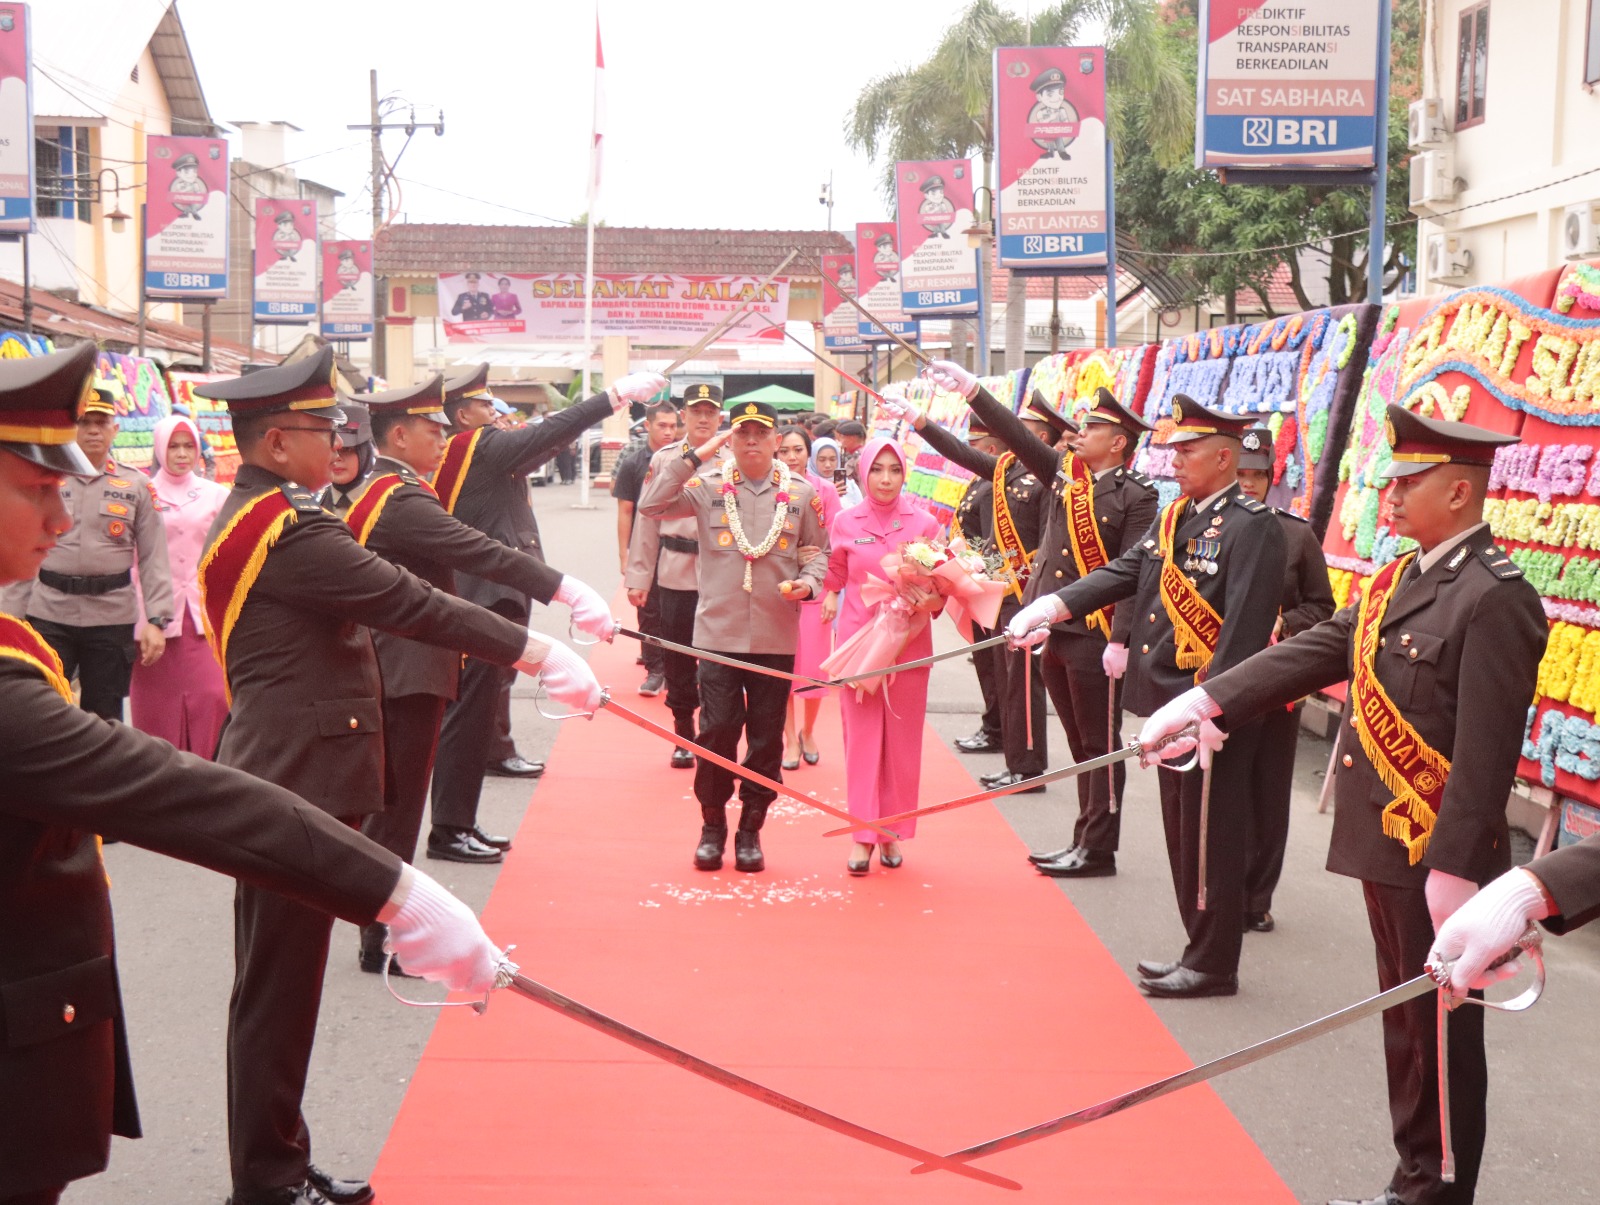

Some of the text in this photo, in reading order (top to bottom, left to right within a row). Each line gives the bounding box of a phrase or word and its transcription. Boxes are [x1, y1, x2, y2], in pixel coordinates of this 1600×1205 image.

[1237, 8, 1306, 20] PREDIKTIF
[1237, 25, 1350, 37] RESPONSIBILITAS
[1237, 42, 1338, 54] TRANSPARANSI
[1236, 58, 1328, 70] BERKEADILAN
[1216, 87, 1365, 107] SAT SABHARA
[1276, 119, 1338, 145] BRI
[1017, 177, 1088, 186] RESPONSIBILITAS
[1017, 188, 1081, 197] TRANSPARANSI
[1017, 198, 1076, 207] BERKEADILAN
[1007, 215, 1099, 231] SAT LANTAS
[1044, 235, 1084, 253] BRI
[180, 274, 210, 287] BRI
[907, 276, 972, 289] SAT RESKRIM
[533, 279, 779, 303] SELAMAT JALAN
[934, 291, 961, 304] BRI
[281, 303, 304, 313] BRI
[343, 324, 363, 332] BRI
[1030, 325, 1085, 337] MEARA
[103, 489, 137, 502] POLRI
[999, 517, 1018, 552] BINJA
[1073, 493, 1106, 572] POLRES BIN
[1164, 570, 1186, 603] RES
[1363, 698, 1421, 770] BINJAI
